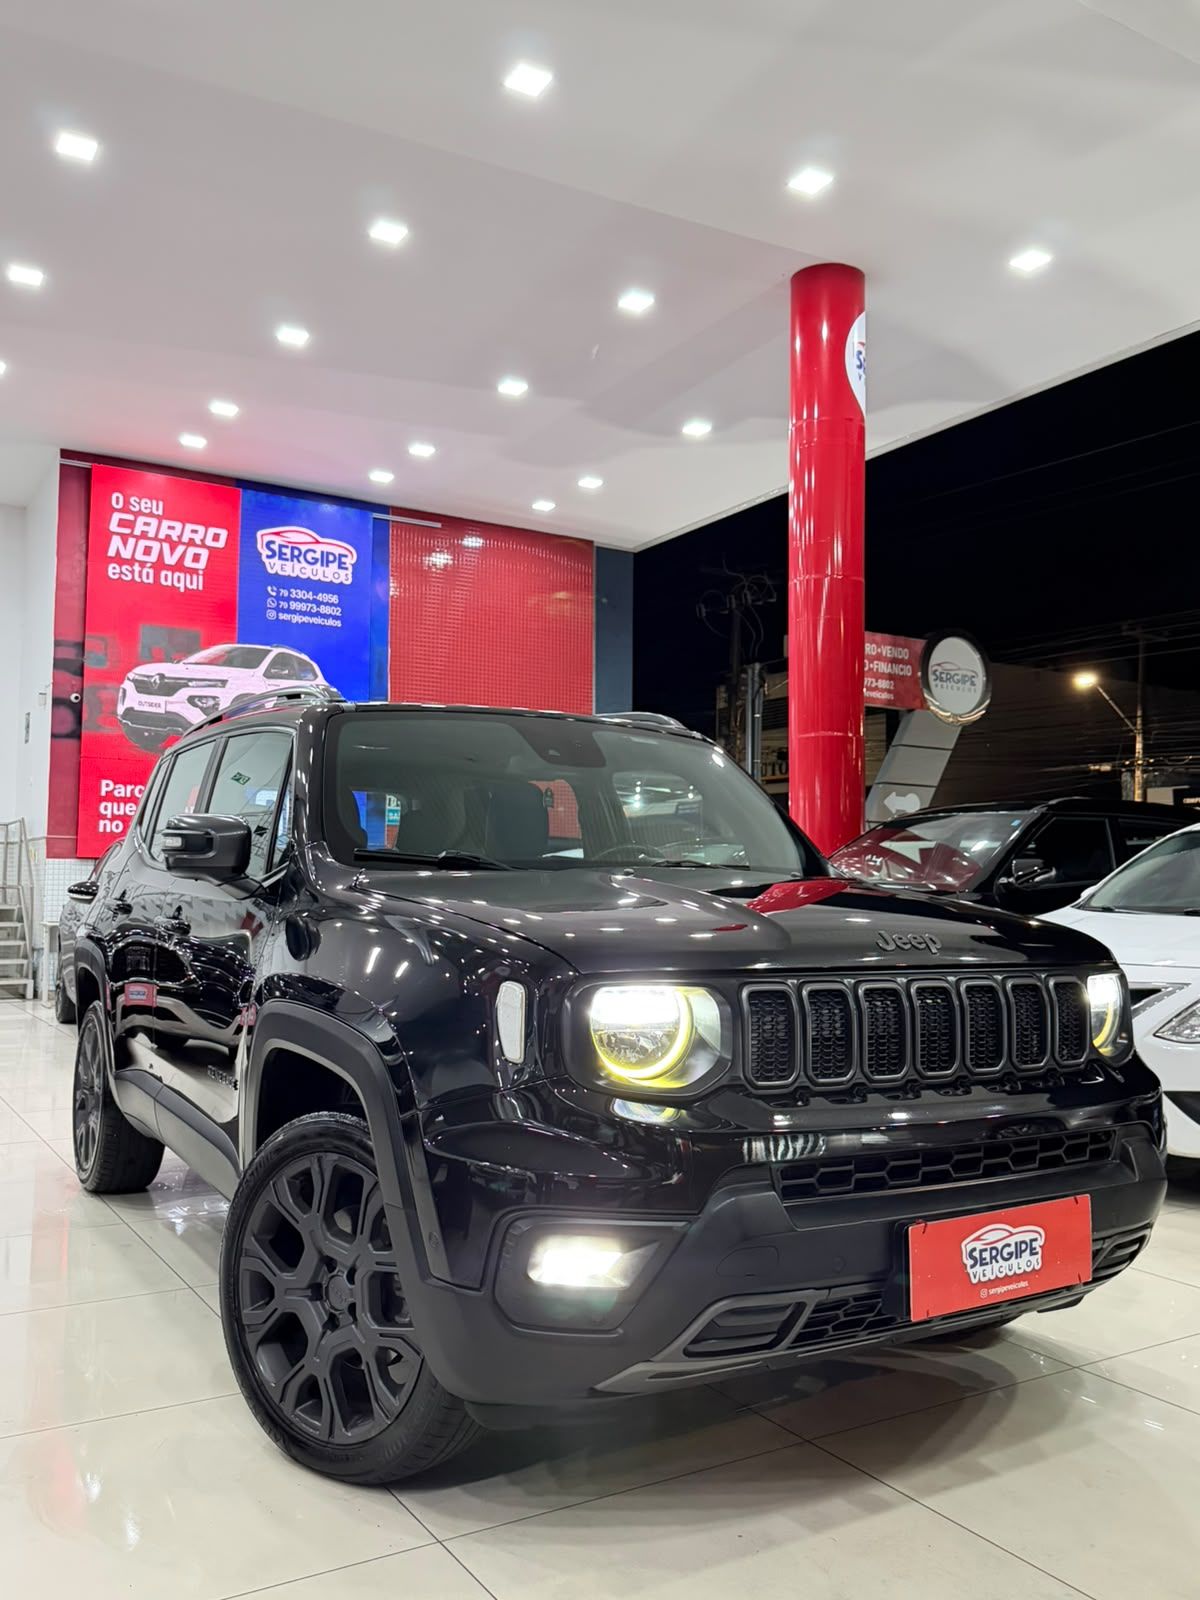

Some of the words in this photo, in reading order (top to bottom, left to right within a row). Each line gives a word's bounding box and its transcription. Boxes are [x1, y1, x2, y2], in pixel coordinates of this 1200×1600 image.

[111, 491, 124, 509] O
[129, 496, 163, 516] seu
[108, 511, 229, 549] CARRO
[107, 534, 209, 570] NOVO
[265, 540, 349, 570] SERGIPE
[107, 562, 154, 584] está
[160, 569, 203, 593] aqui
[289, 588, 339, 604] 3304-4956
[289, 600, 342, 616] 99973-8802
[278, 612, 342, 627] sergipeveiculos
[932, 668, 977, 688] SERGIPE
[100, 779, 145, 798] Parc
[99, 801, 137, 818] que
[98, 819, 124, 833] no
[876, 930, 942, 955] Jeep
[968, 1238, 1039, 1269] SERGIPE
